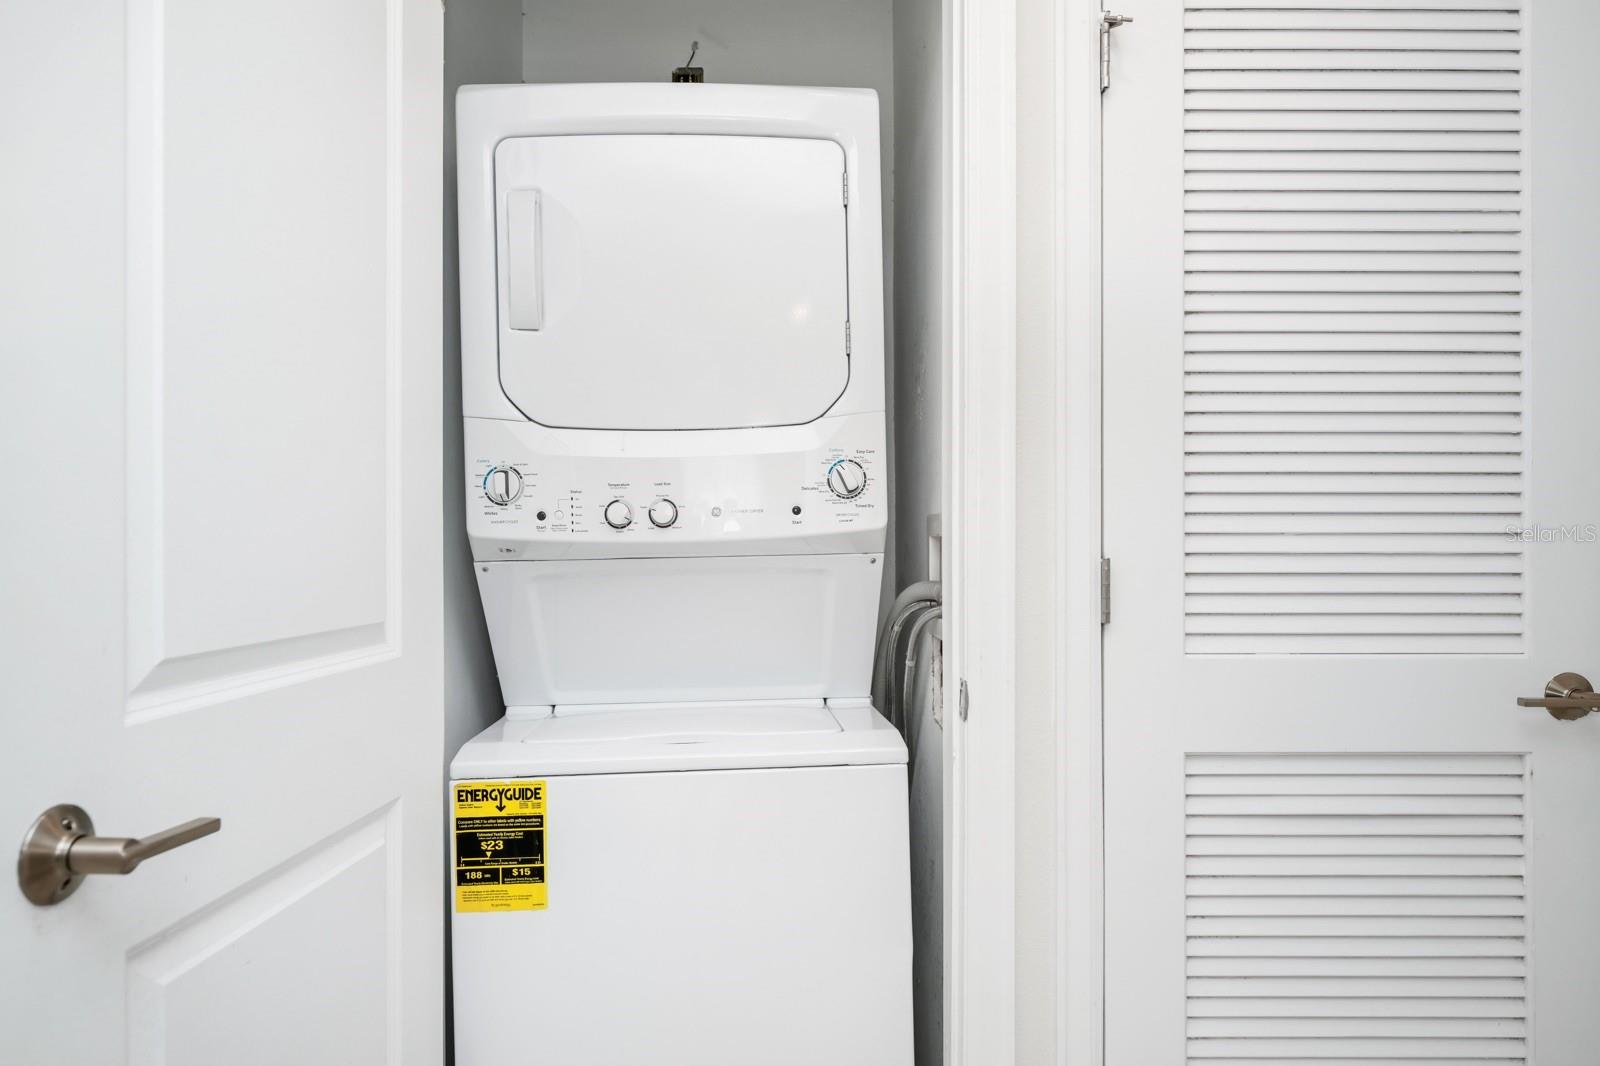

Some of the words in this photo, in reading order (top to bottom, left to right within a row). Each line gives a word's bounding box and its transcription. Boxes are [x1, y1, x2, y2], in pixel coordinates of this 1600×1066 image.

[457, 787, 542, 802] ENERGYGUIDE
[480, 840, 504, 850] $23
[465, 871, 482, 879] 188
[512, 867, 531, 876] $15
